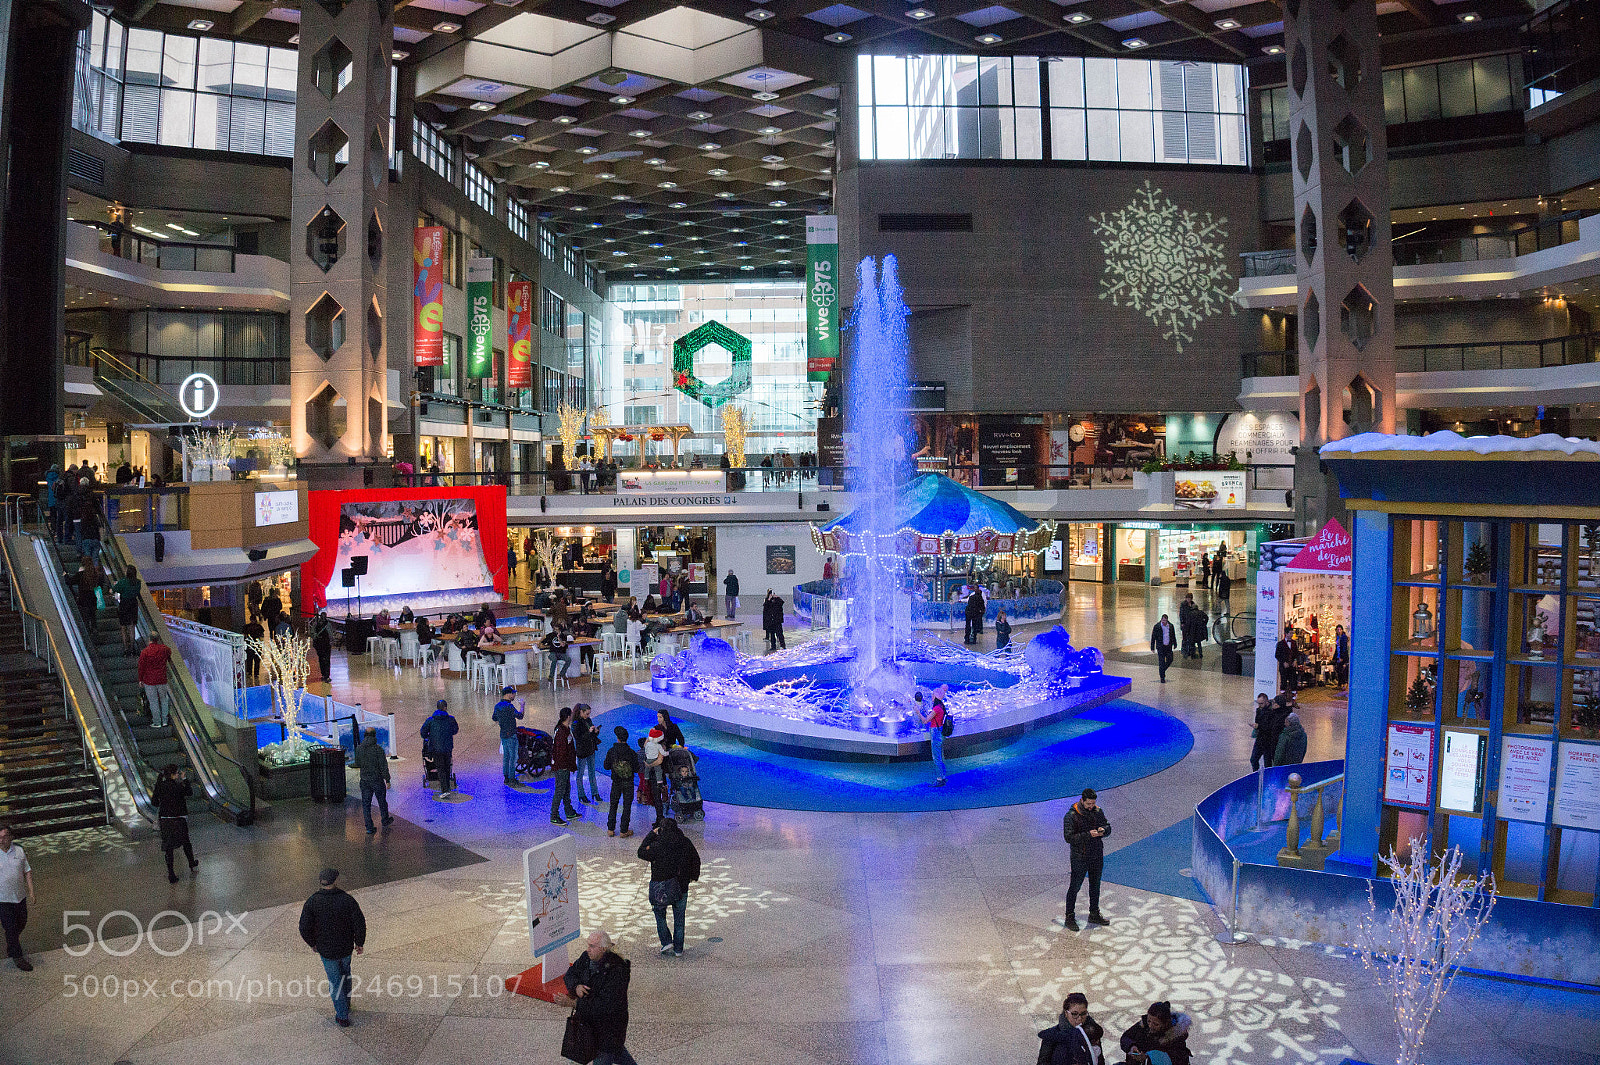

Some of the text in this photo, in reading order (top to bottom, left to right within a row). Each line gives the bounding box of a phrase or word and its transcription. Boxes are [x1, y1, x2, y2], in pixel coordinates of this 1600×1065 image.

[815, 307, 828, 340] vive
[473, 335, 485, 364] vive
[613, 497, 647, 506] PALAIS
[650, 497, 669, 506] DES
[1309, 533, 1350, 553] marché
[1319, 528, 1335, 543] Le
[1317, 550, 1331, 562] de
